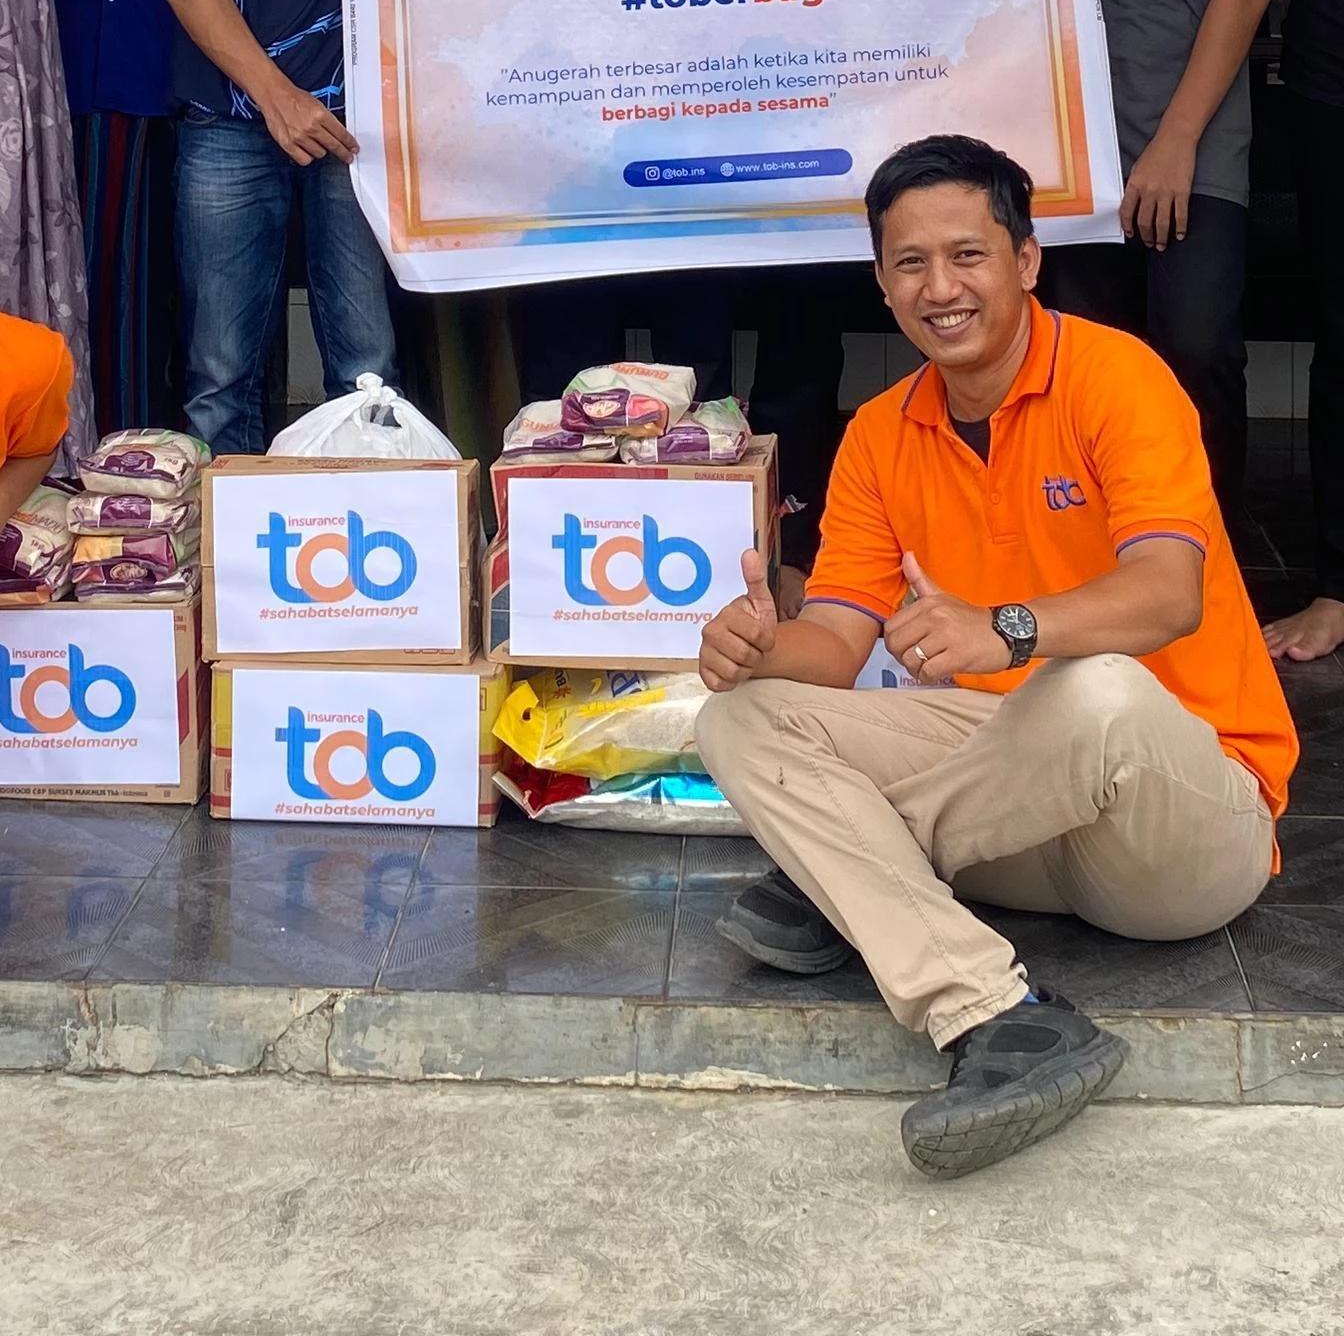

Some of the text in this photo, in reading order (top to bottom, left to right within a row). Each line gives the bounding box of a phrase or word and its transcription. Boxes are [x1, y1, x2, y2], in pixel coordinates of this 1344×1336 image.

[606, 62, 682, 76] terbesar
[688, 55, 748, 72] adalah
[755, 52, 808, 68] ketika
[815, 50, 846, 64] kita
[854, 44, 930, 62] memiliki
[486, 64, 948, 107] kemampuan dan memperoleh kesempatan untuk
[603, 102, 675, 121] berbagi
[682, 99, 752, 118] kepada
[663, 168, 705, 179] @tob.ins
[736, 161, 819, 172] www.tob-ins.com
[289, 516, 345, 526] insurance
[583, 517, 641, 530] insurance
[257, 510, 417, 603] tob
[552, 513, 712, 606] tob
[260, 606, 418, 619] #sahabatselamanya
[553, 608, 715, 626] #sahabatselamanya
[12, 648, 66, 658] insurance
[308, 712, 365, 723] insurance
[275, 707, 436, 801] tob
[275, 802, 436, 820] #sahabatselamanya
